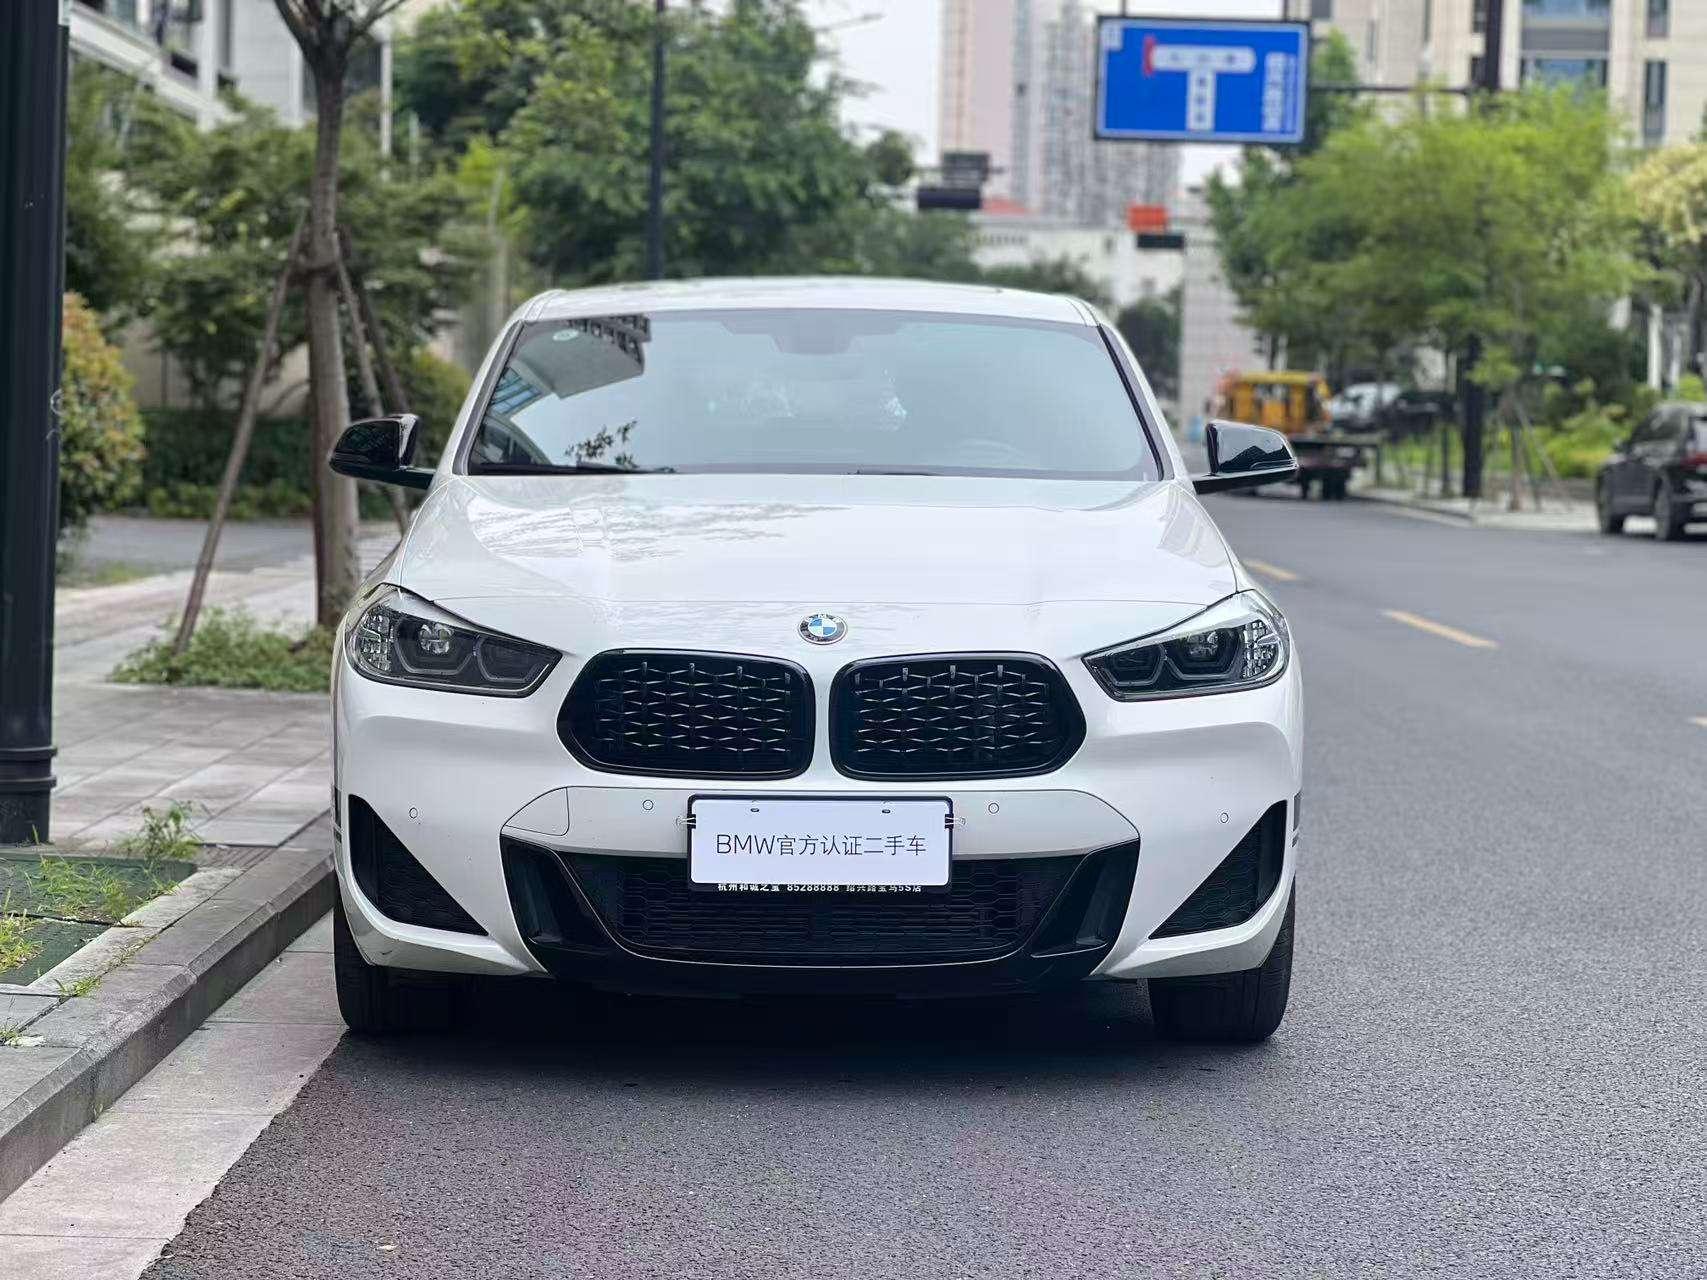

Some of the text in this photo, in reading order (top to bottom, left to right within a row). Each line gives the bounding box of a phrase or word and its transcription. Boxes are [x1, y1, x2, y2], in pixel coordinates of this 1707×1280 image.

[716, 834, 927, 856] BMW官方认证二手车
